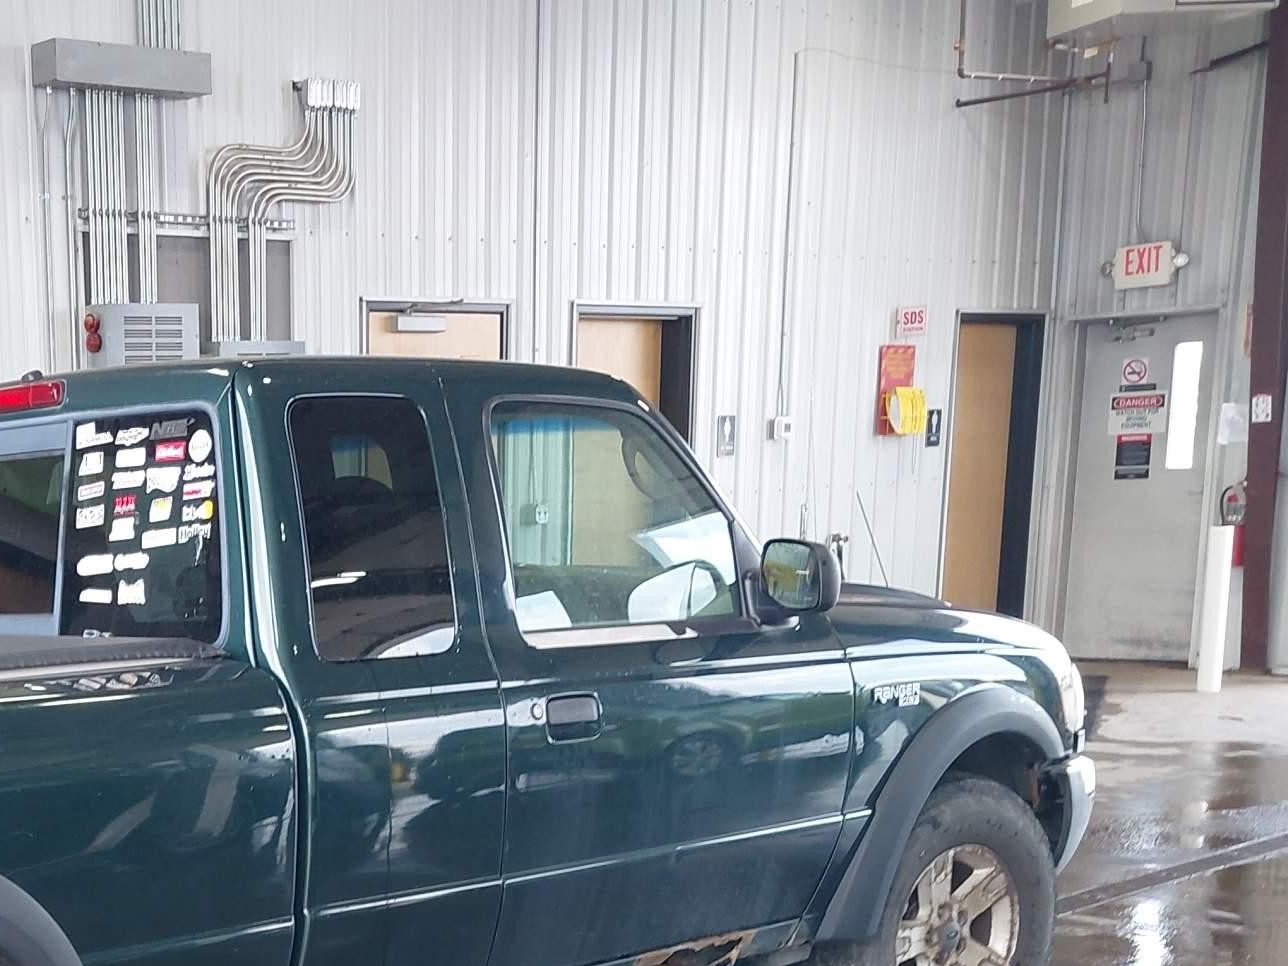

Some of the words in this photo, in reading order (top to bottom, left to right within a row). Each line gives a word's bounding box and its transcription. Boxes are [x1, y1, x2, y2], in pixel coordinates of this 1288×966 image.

[1125, 245, 1163, 276] EXIT
[903, 310, 924, 325] SDS
[1119, 397, 1157, 407] DANGER
[874, 682, 920, 704] RANGER
